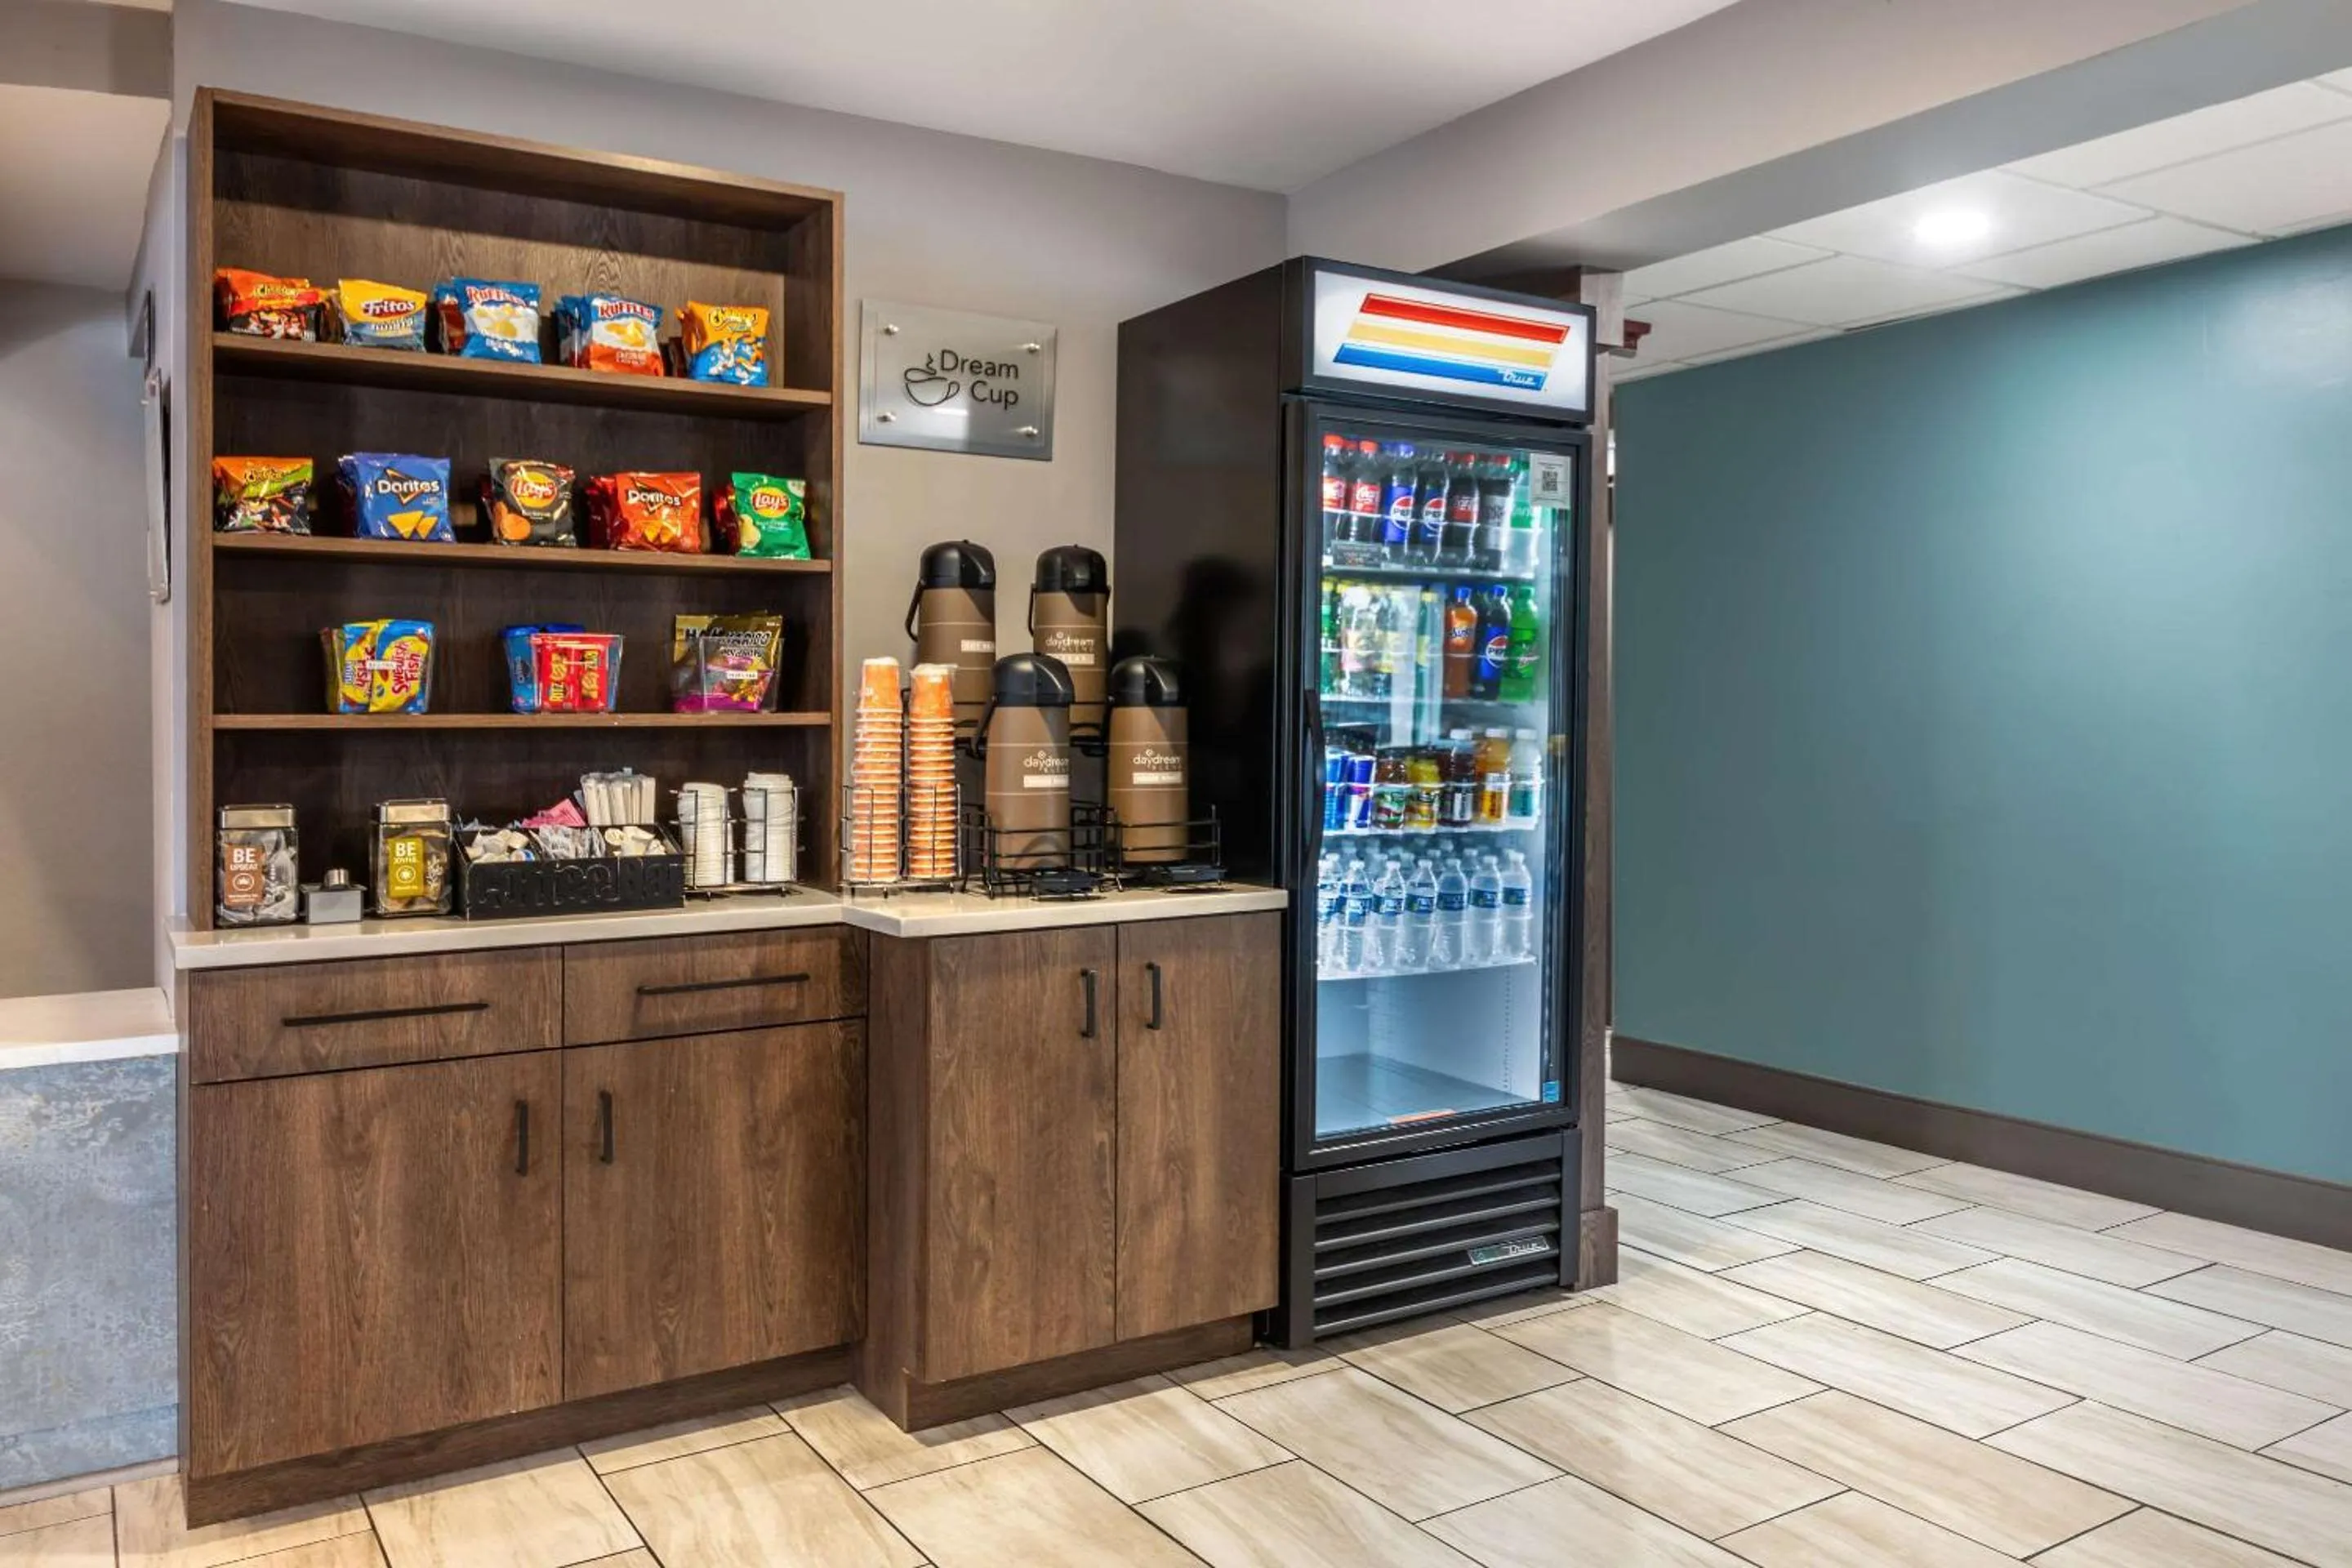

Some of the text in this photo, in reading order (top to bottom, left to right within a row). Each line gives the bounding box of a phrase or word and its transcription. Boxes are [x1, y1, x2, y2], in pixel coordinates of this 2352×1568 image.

[361, 297, 415, 315] Fritos
[940, 349, 1018, 380] Dream
[970, 380, 1019, 411] Cup
[377, 479, 440, 494] Doritos
[626, 489, 682, 506] Doritos
[1045, 634, 1094, 651] daydream
[233, 848, 256, 863] BE
[395, 841, 417, 857] BE
